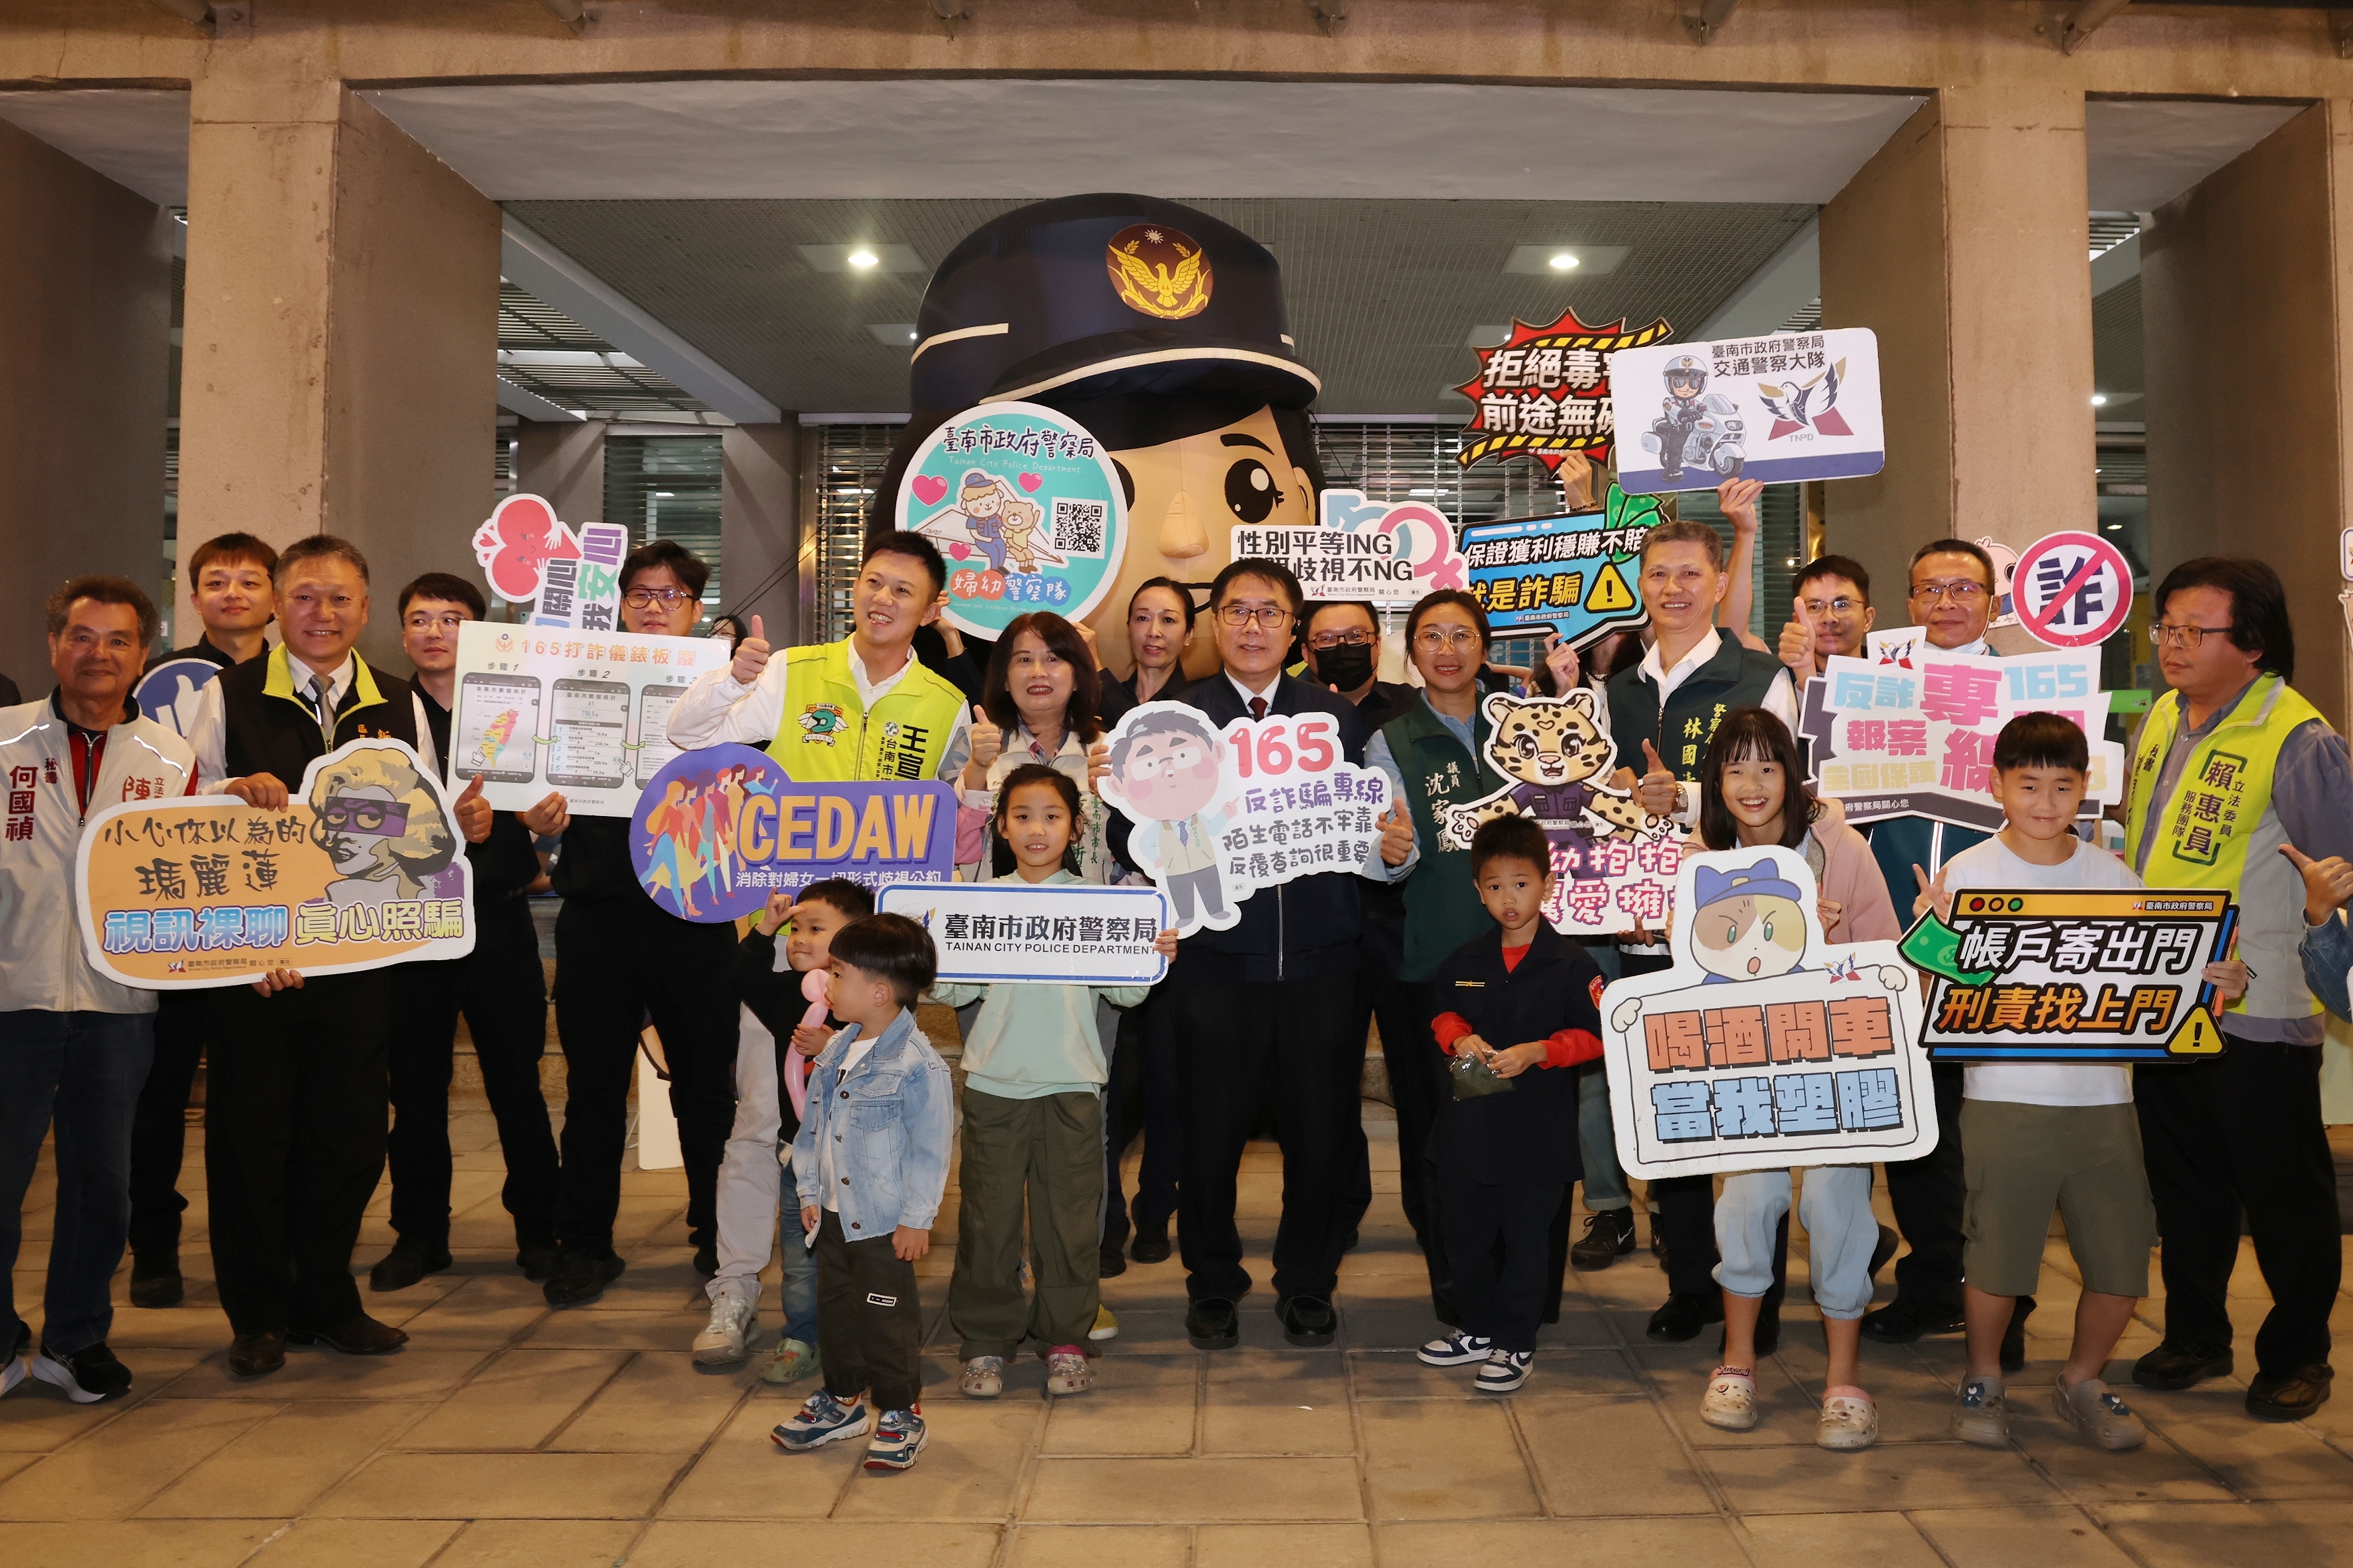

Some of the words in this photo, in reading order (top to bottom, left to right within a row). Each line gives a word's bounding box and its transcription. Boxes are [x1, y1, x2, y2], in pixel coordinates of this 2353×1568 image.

[1712, 335, 1824, 359] 臺南市政府警察局
[1714, 351, 1826, 378] 交通警察大隊
[1483, 348, 1611, 389] 拒絕毒
[943, 426, 1094, 458] 臺南市政府警察局
[1788, 433, 1814, 442] TNPD
[948, 456, 976, 465] Tainan
[980, 458, 998, 468] City
[1003, 460, 1028, 469] Police
[1032, 462, 1081, 473] Department
[1237, 530, 1392, 555] 性別平等ING
[1465, 526, 1648, 567] 保證獲利穩賺不賠
[577, 528, 621, 631] 我安心
[952, 572, 1068, 602] 婦幼警察隊
[1238, 556, 1412, 582] 歧視不NG
[535, 559, 577, 628] 關心
[2037, 556, 2103, 625] 詐
[602, 671, 610, 679] 2
[1834, 672, 1916, 711] 反詐
[2005, 664, 2088, 701] 165
[894, 725, 928, 781] 王宣
[1229, 722, 1334, 778] 165
[1847, 718, 1927, 757] 報案
[45, 757, 59, 784] 秘書
[881, 738, 897, 781] 台南市
[1446, 761, 1461, 787] 議員
[1822, 760, 1937, 791] 全國保護
[2143, 743, 2161, 772] 秘書
[5, 765, 39, 841] 何國禎
[122, 775, 151, 802] 陳
[154, 777, 165, 799] 立法
[1245, 773, 1383, 814] 反詐騙專線
[1845, 799, 1909, 812] 府警察局關心您
[2183, 760, 2237, 855] 賴惠員
[2172, 790, 2198, 837] 服務團隊
[2218, 780, 2247, 837] 立法委員
[105, 815, 306, 847] 小心你以為的
[739, 794, 934, 863] CEDAW
[1192, 827, 1201, 847] MAYOR
[1222, 806, 1373, 851] 陌生電話不牢靠
[137, 850, 279, 899] 瑪麗蓮
[1229, 839, 1369, 879] 反覆查詢很重要
[1541, 880, 1675, 922] 愛擁
[2145, 901, 2213, 910] 臺南市政府警察局
[105, 907, 287, 952] 視訊裸聊
[944, 913, 1157, 943] 臺南市政府警察局
[1959, 924, 2197, 971] 帳戶寄出門
[946, 941, 992, 951] TAINAN
[994, 943, 1022, 952] CITY
[1025, 943, 1069, 953] POLICE
[1073, 944, 1156, 955] DEPARTMENT
[1938, 987, 2179, 1031] 刑責找上門
[1643, 996, 1896, 1074] 喝酒開車
